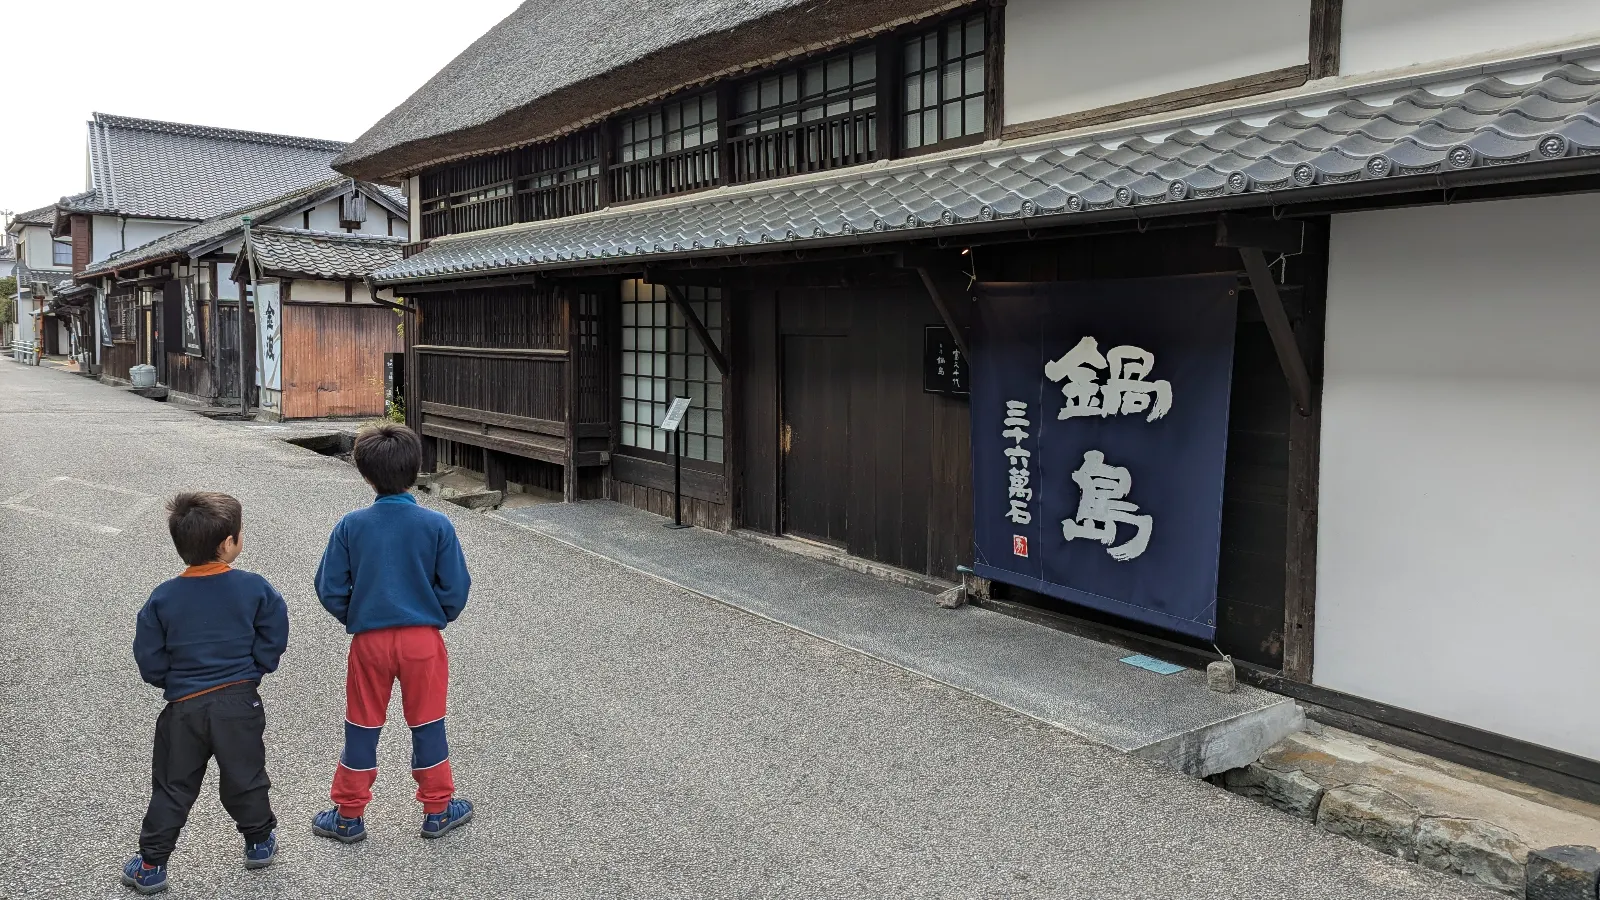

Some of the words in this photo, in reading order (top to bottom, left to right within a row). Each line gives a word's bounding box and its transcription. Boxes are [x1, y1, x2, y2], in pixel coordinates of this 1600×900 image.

[1001, 399, 1033, 525] 三十六萬石
[1044, 335, 1173, 562] 鍋島
